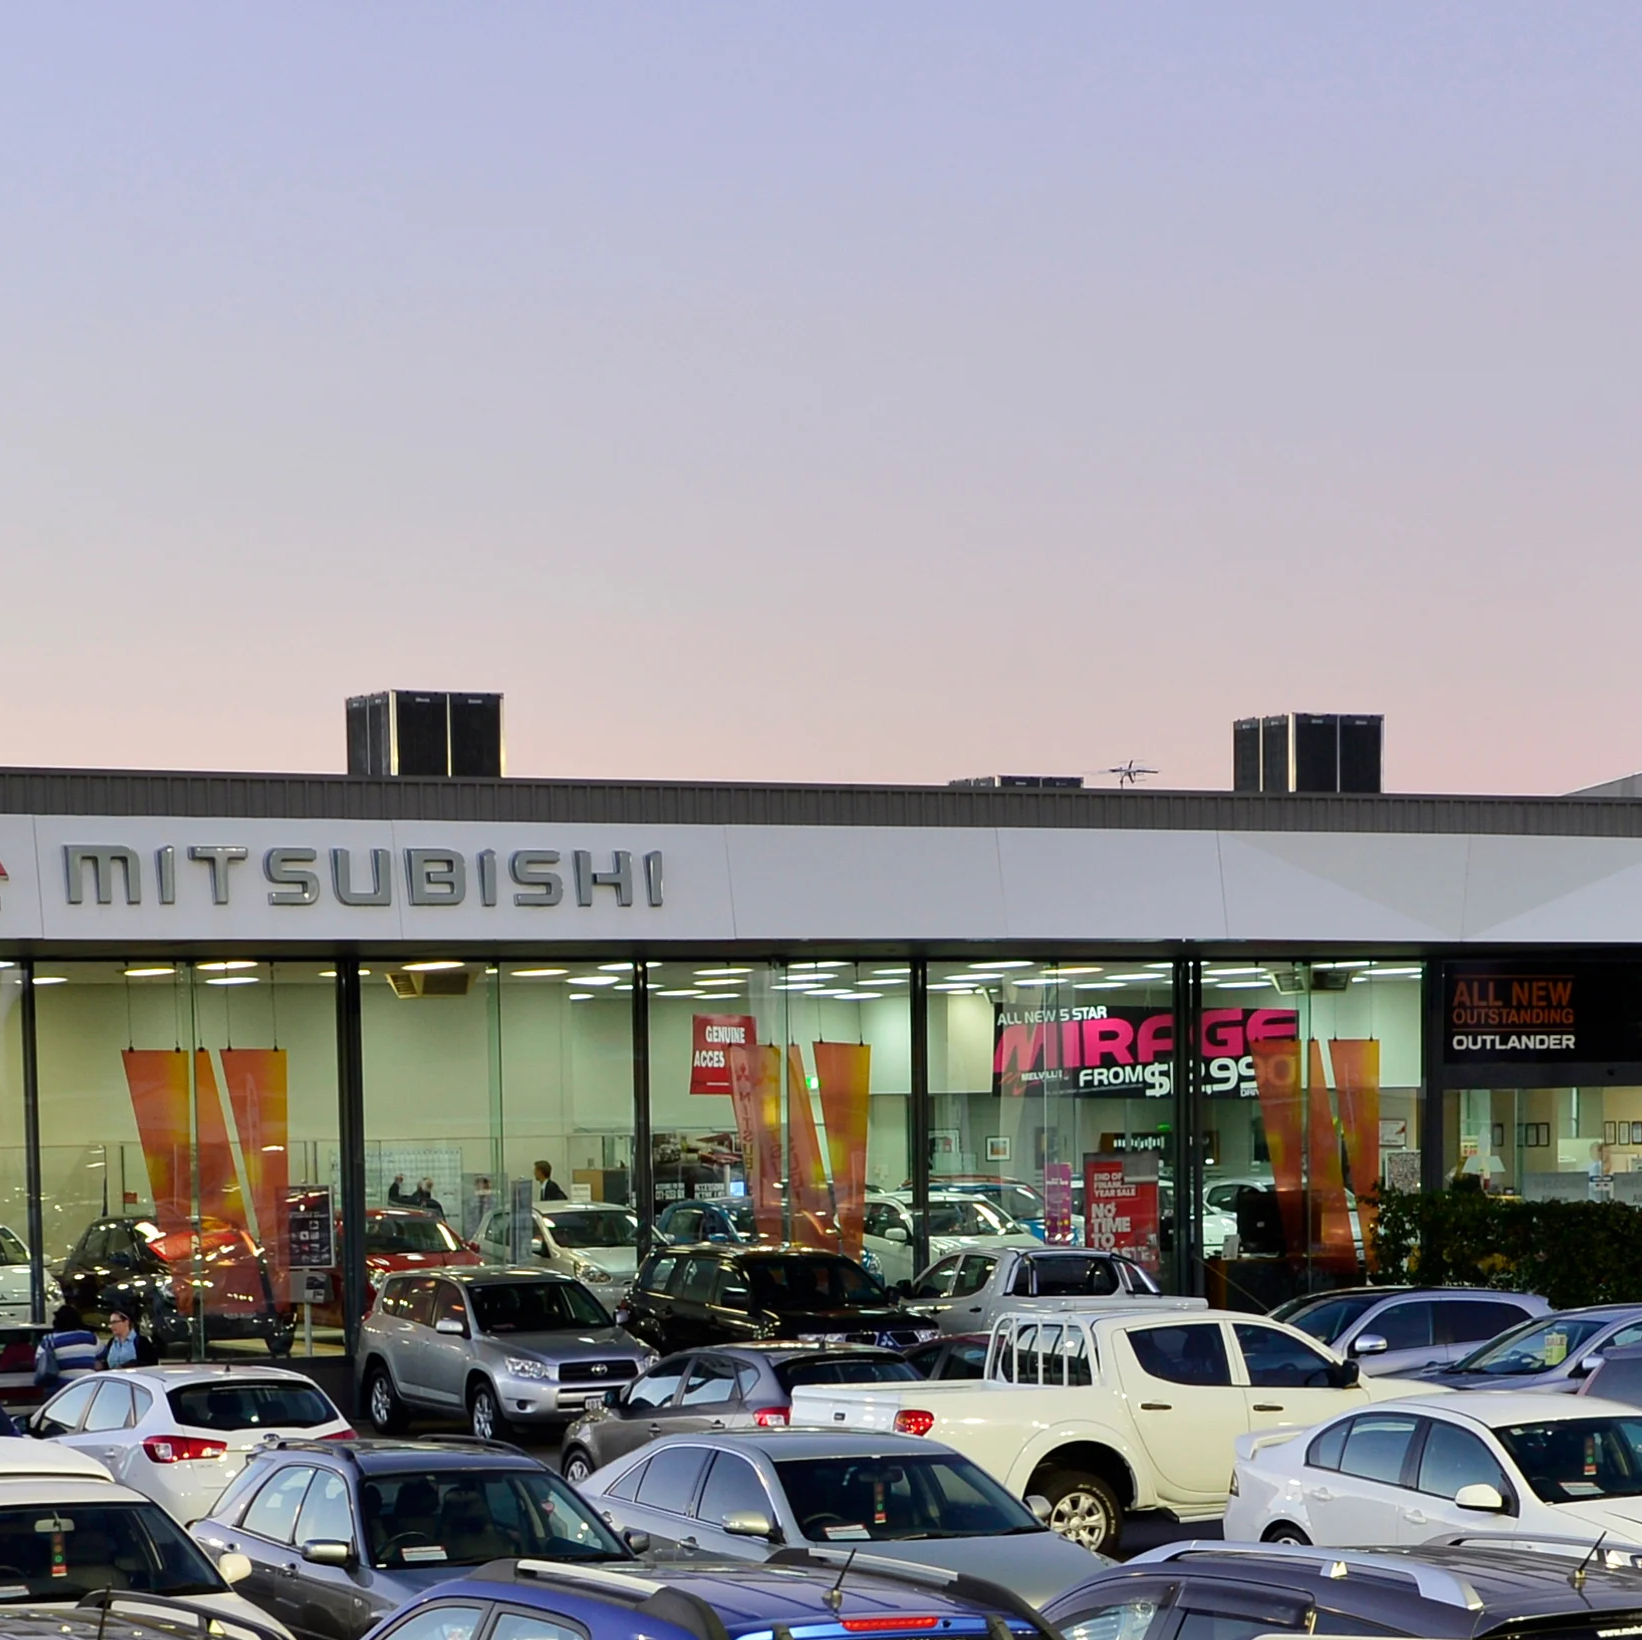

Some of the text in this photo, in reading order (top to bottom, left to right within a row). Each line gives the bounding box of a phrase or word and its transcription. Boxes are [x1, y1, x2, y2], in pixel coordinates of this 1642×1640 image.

[63, 845, 664, 907] MITSUBISHI
[1452, 981, 1573, 1006] ALL NEW
[997, 1005, 1107, 1026] ALL NEW 5 STAR
[1452, 1008, 1574, 1025] OUTSTANDING
[705, 1026, 746, 1044] GENUINE
[1452, 1035, 1576, 1050] OUTLANDER
[1079, 1065, 1143, 1087] FROM
[1091, 1202, 1116, 1218] NO
[1091, 1217, 1131, 1232] TIME
[1091, 1232, 1115, 1248] TO
